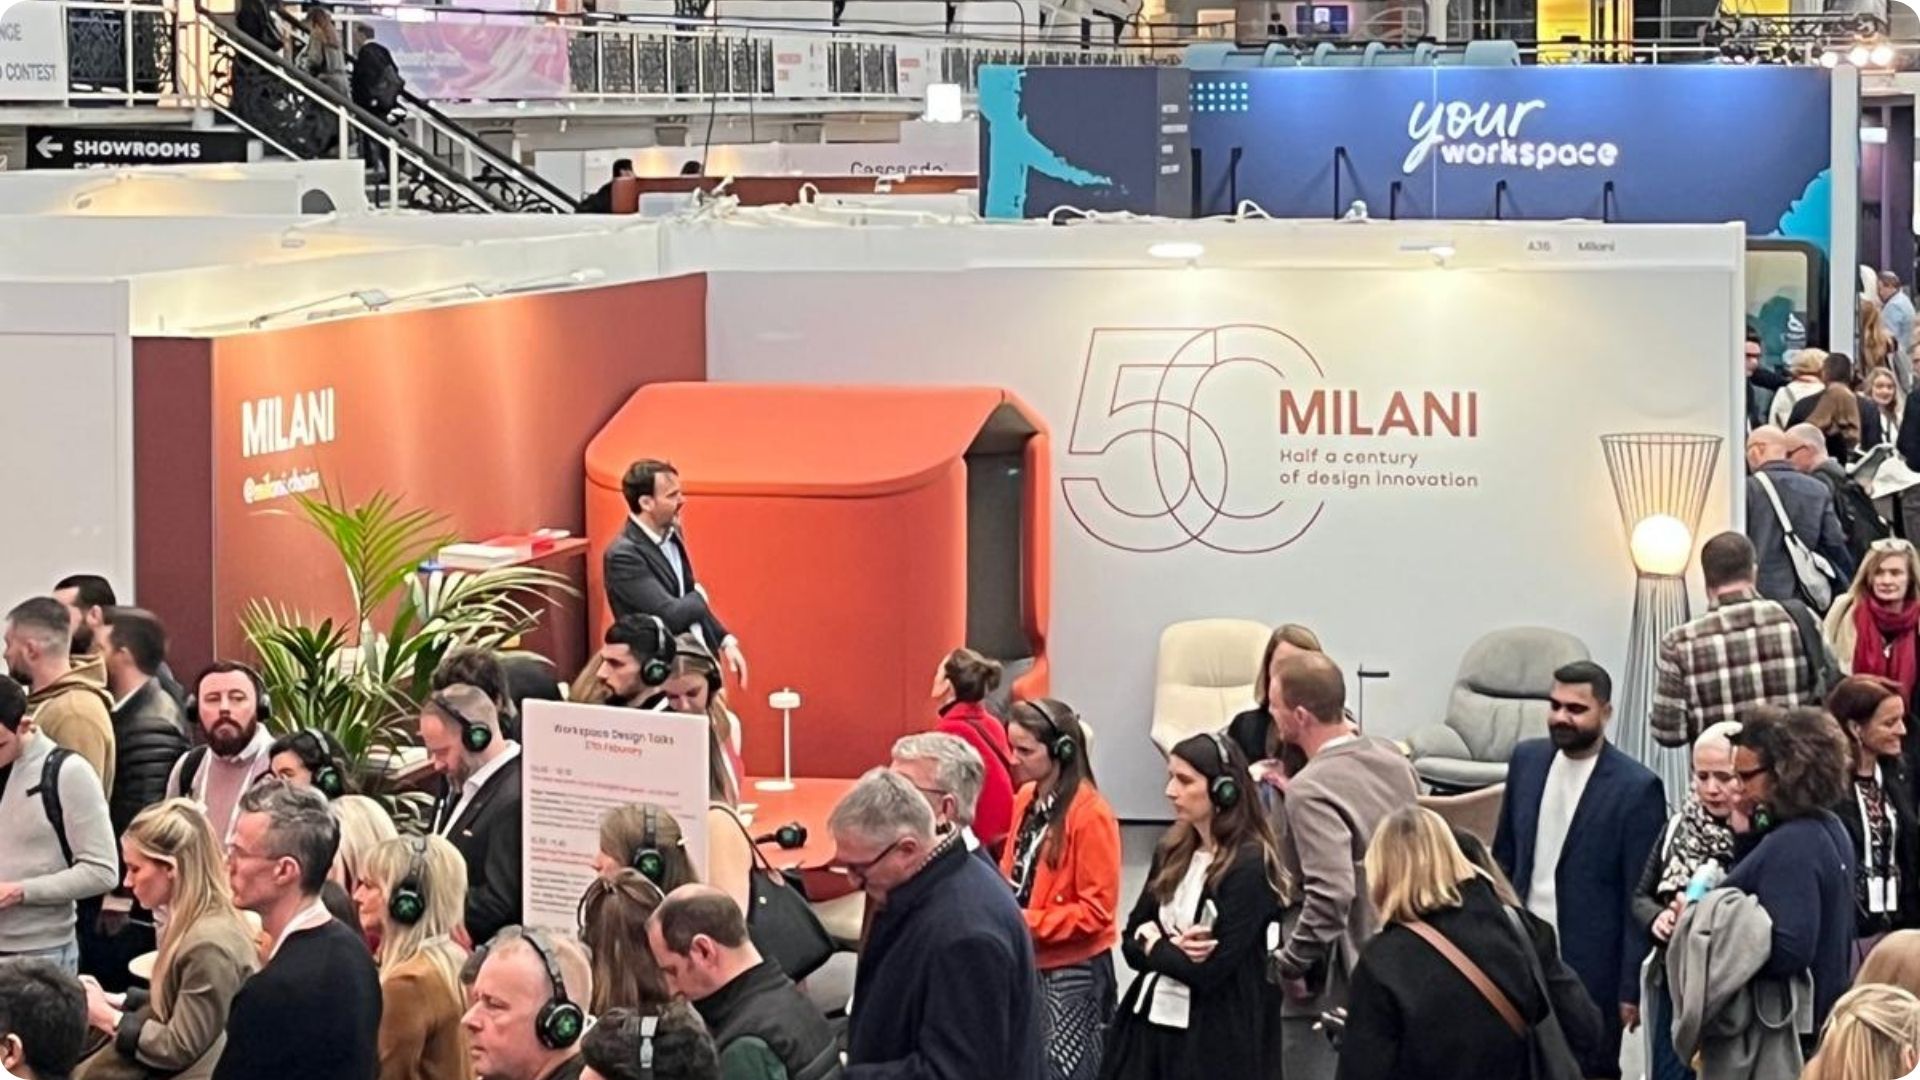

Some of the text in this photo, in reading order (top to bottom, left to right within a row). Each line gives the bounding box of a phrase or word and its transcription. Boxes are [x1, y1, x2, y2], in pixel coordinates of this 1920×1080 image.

[6, 62, 56, 82] CONTEST
[1402, 98, 1546, 174] your
[73, 140, 201, 159] SHOWROOMS
[1440, 138, 1619, 170] workspace
[242, 386, 335, 458] MILANI
[1279, 389, 1478, 438] MILANI
[1279, 449, 1419, 469] Half a century
[1279, 469, 1479, 489] of design innovation
[554, 724, 675, 746] Workspace Design Talks
